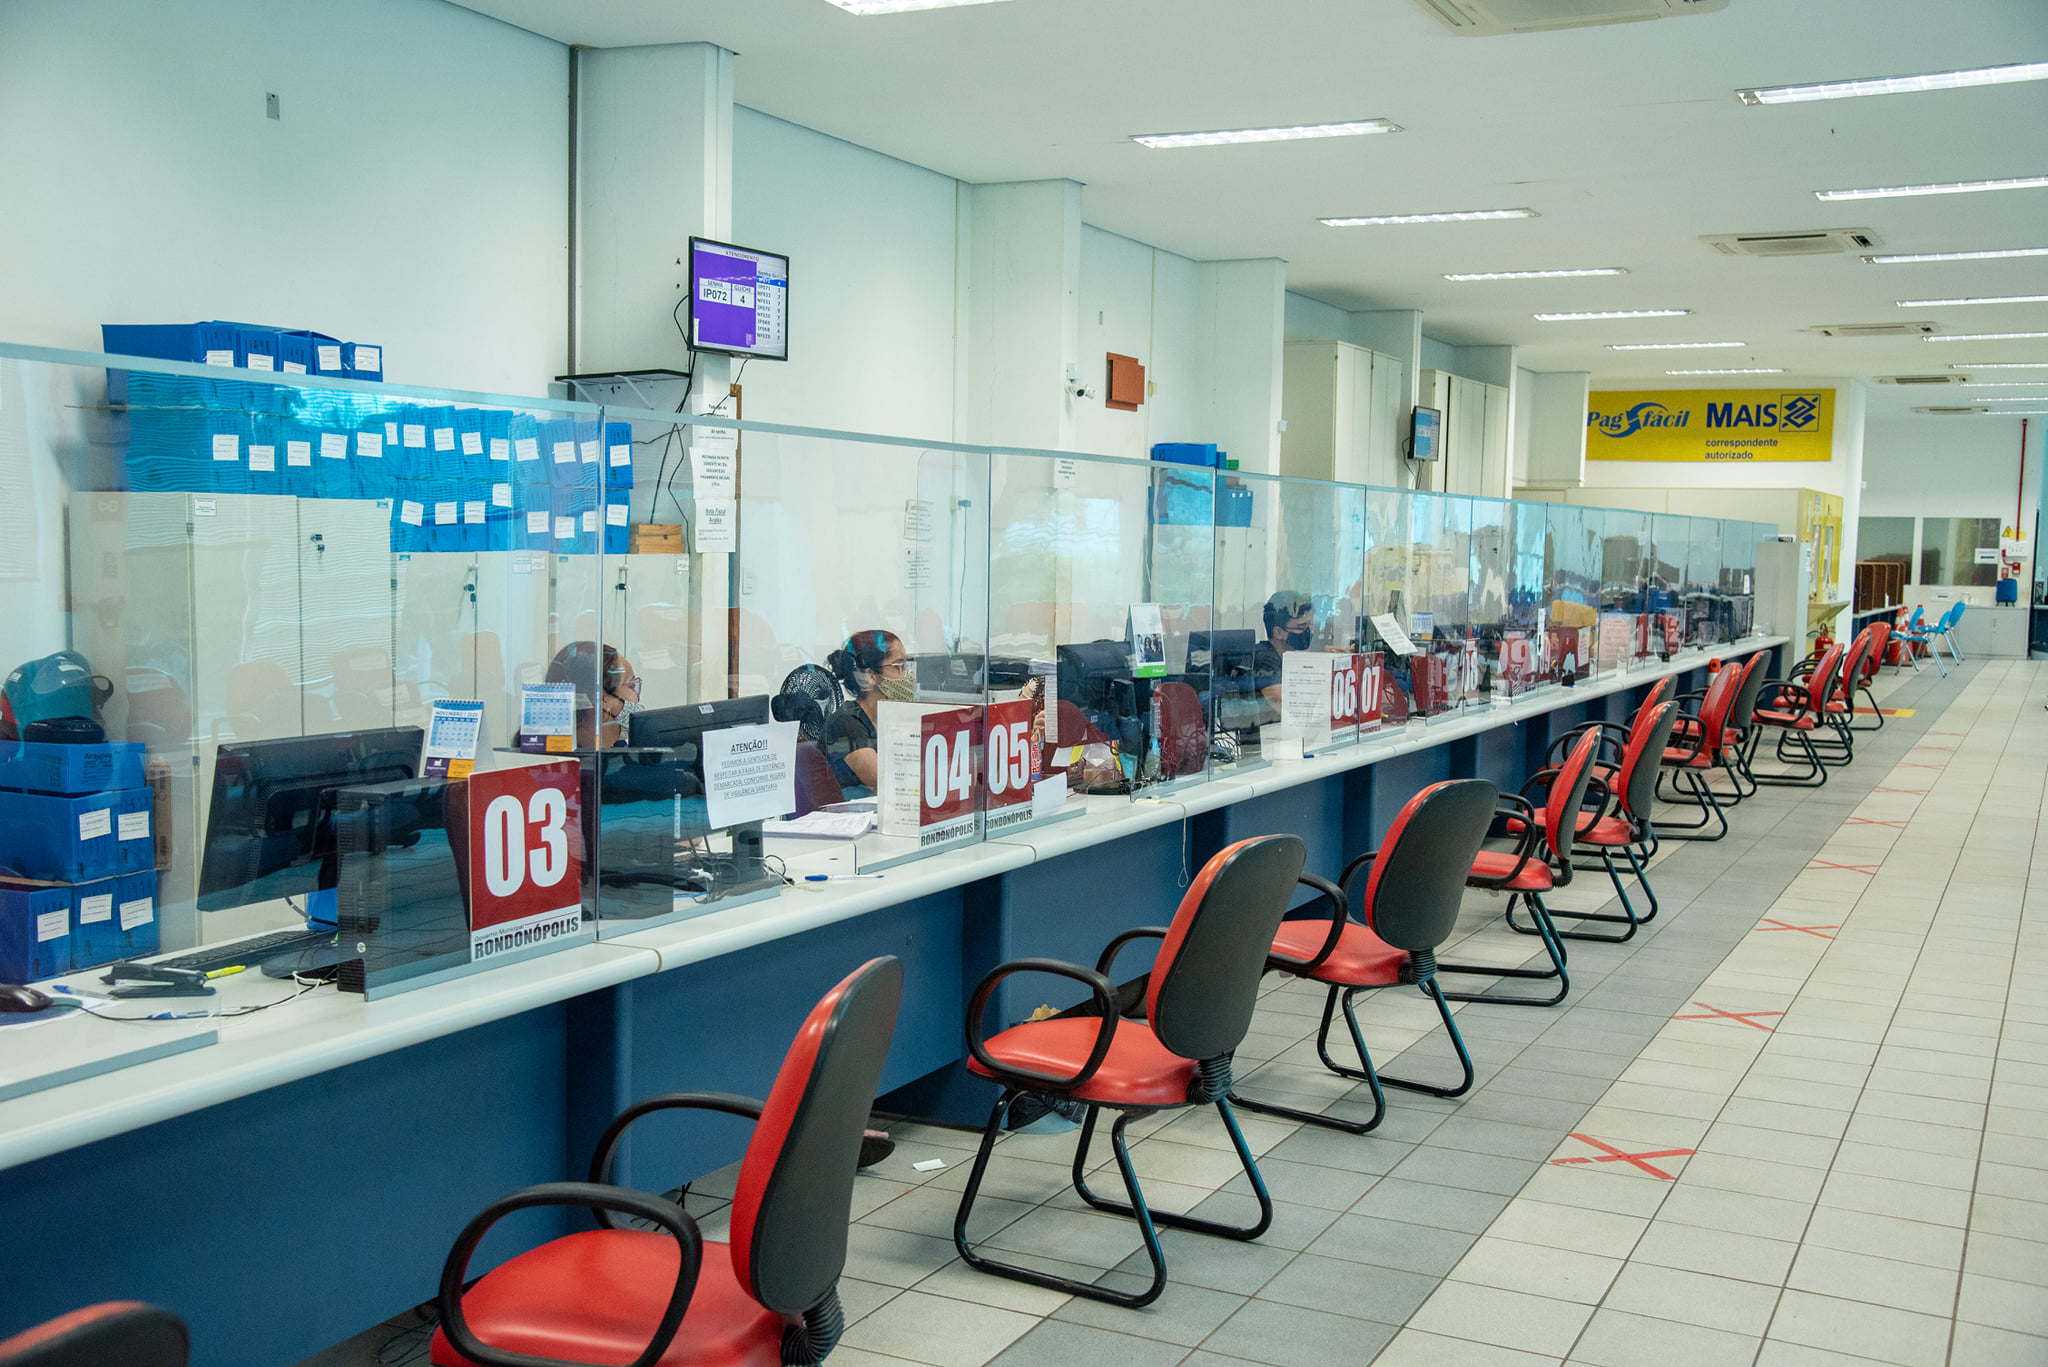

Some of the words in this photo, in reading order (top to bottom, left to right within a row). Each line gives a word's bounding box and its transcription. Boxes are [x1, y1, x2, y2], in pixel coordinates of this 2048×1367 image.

[703, 288, 727, 301] IP072
[740, 295, 745, 304] 4
[707, 280, 723, 288] SENHA
[1587, 411, 1624, 431] Pag
[1642, 410, 1690, 428] fácil
[1706, 402, 1777, 428] MAIS
[1705, 438, 1778, 449] correspondente
[1705, 451, 1753, 460] autorizado
[1332, 669, 1357, 720] 06
[1362, 666, 1381, 714] 07
[924, 729, 972, 809] 04
[988, 721, 1029, 795] 05
[484, 788, 569, 897] 03
[920, 822, 974, 847] RONDONÓPOLIS
[474, 930, 498, 942] Governo
[499, 923, 525, 934] Municipal
[475, 916, 579, 959] RONDONÓPOLIS
